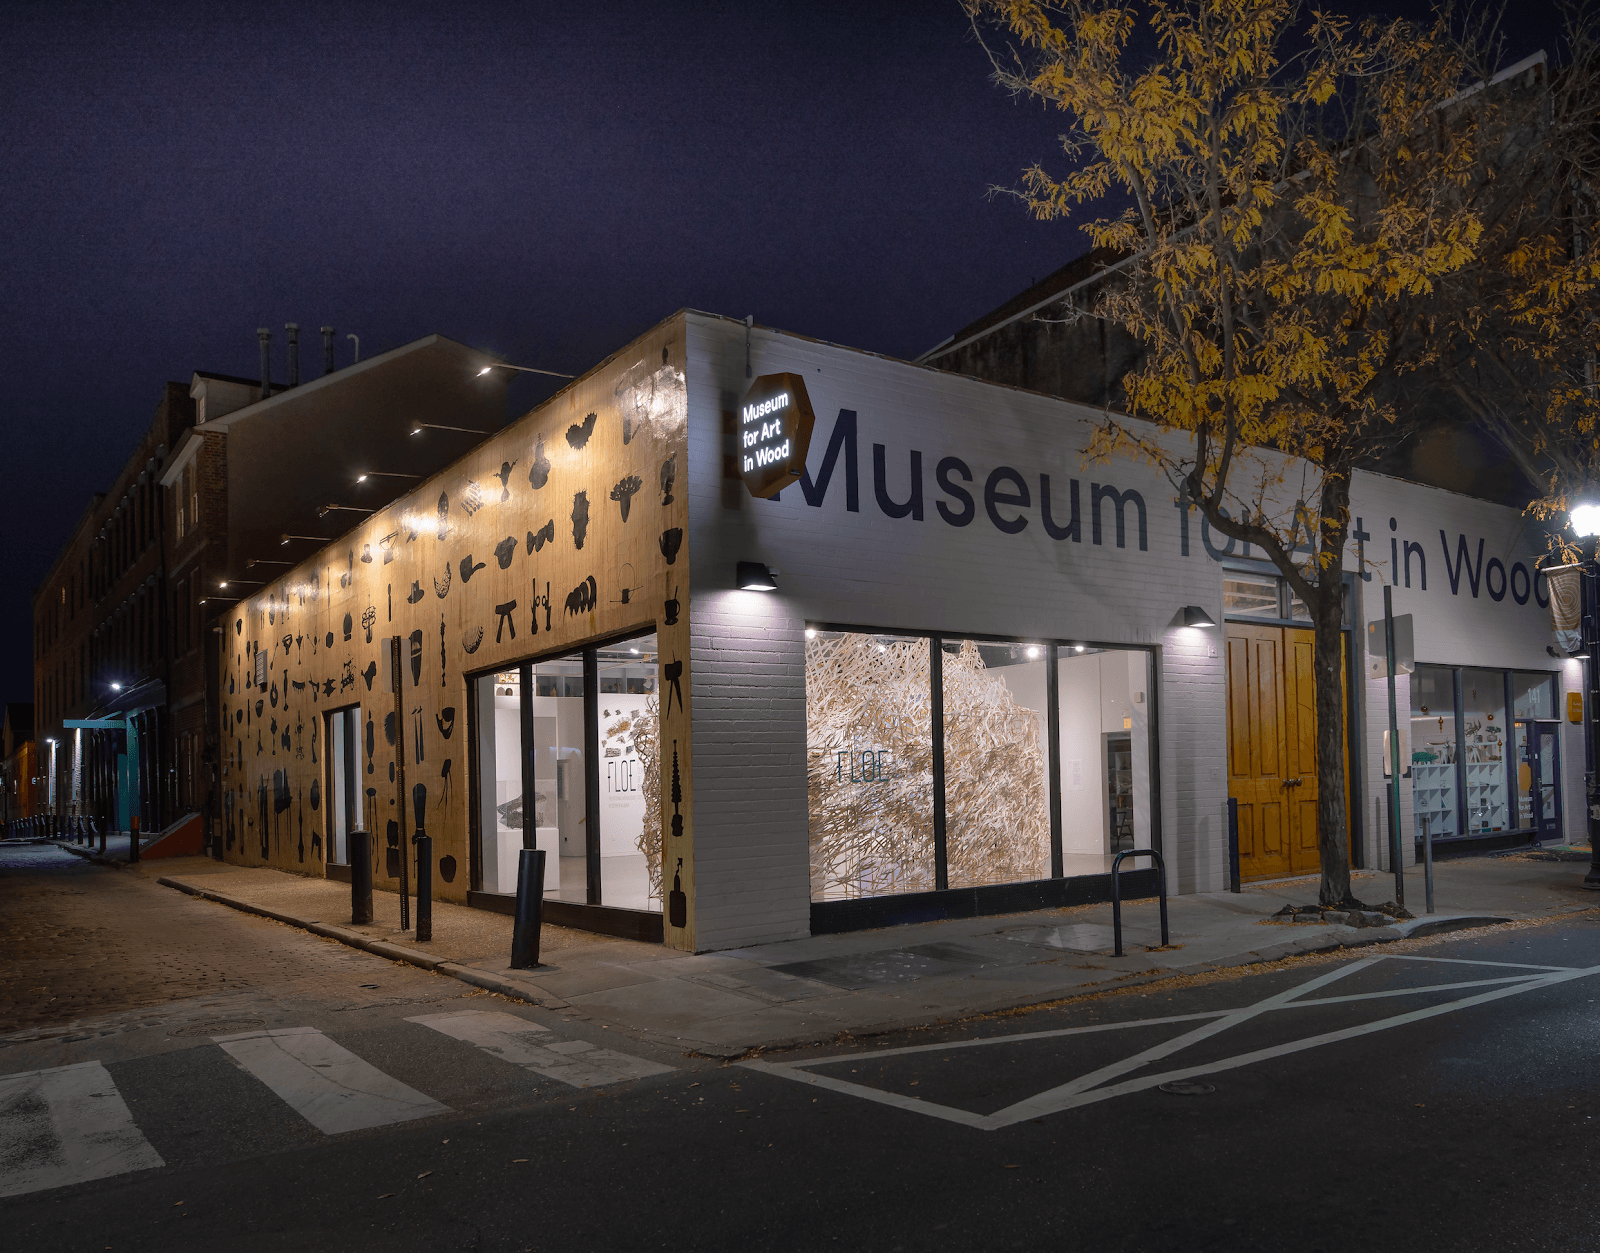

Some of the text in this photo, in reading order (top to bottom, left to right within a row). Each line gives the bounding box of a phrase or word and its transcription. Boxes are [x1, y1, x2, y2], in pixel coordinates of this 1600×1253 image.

[743, 392, 789, 424] Museum
[743, 418, 781, 448] for Art
[743, 438, 789, 473] in Wood
[766, 408, 1148, 553] Museum
[1285, 499, 1372, 583] At
[1389, 516, 1427, 591] in
[1527, 687, 1541, 704] 141
[607, 759, 637, 793] FLOE
[836, 750, 889, 783] FLOE
